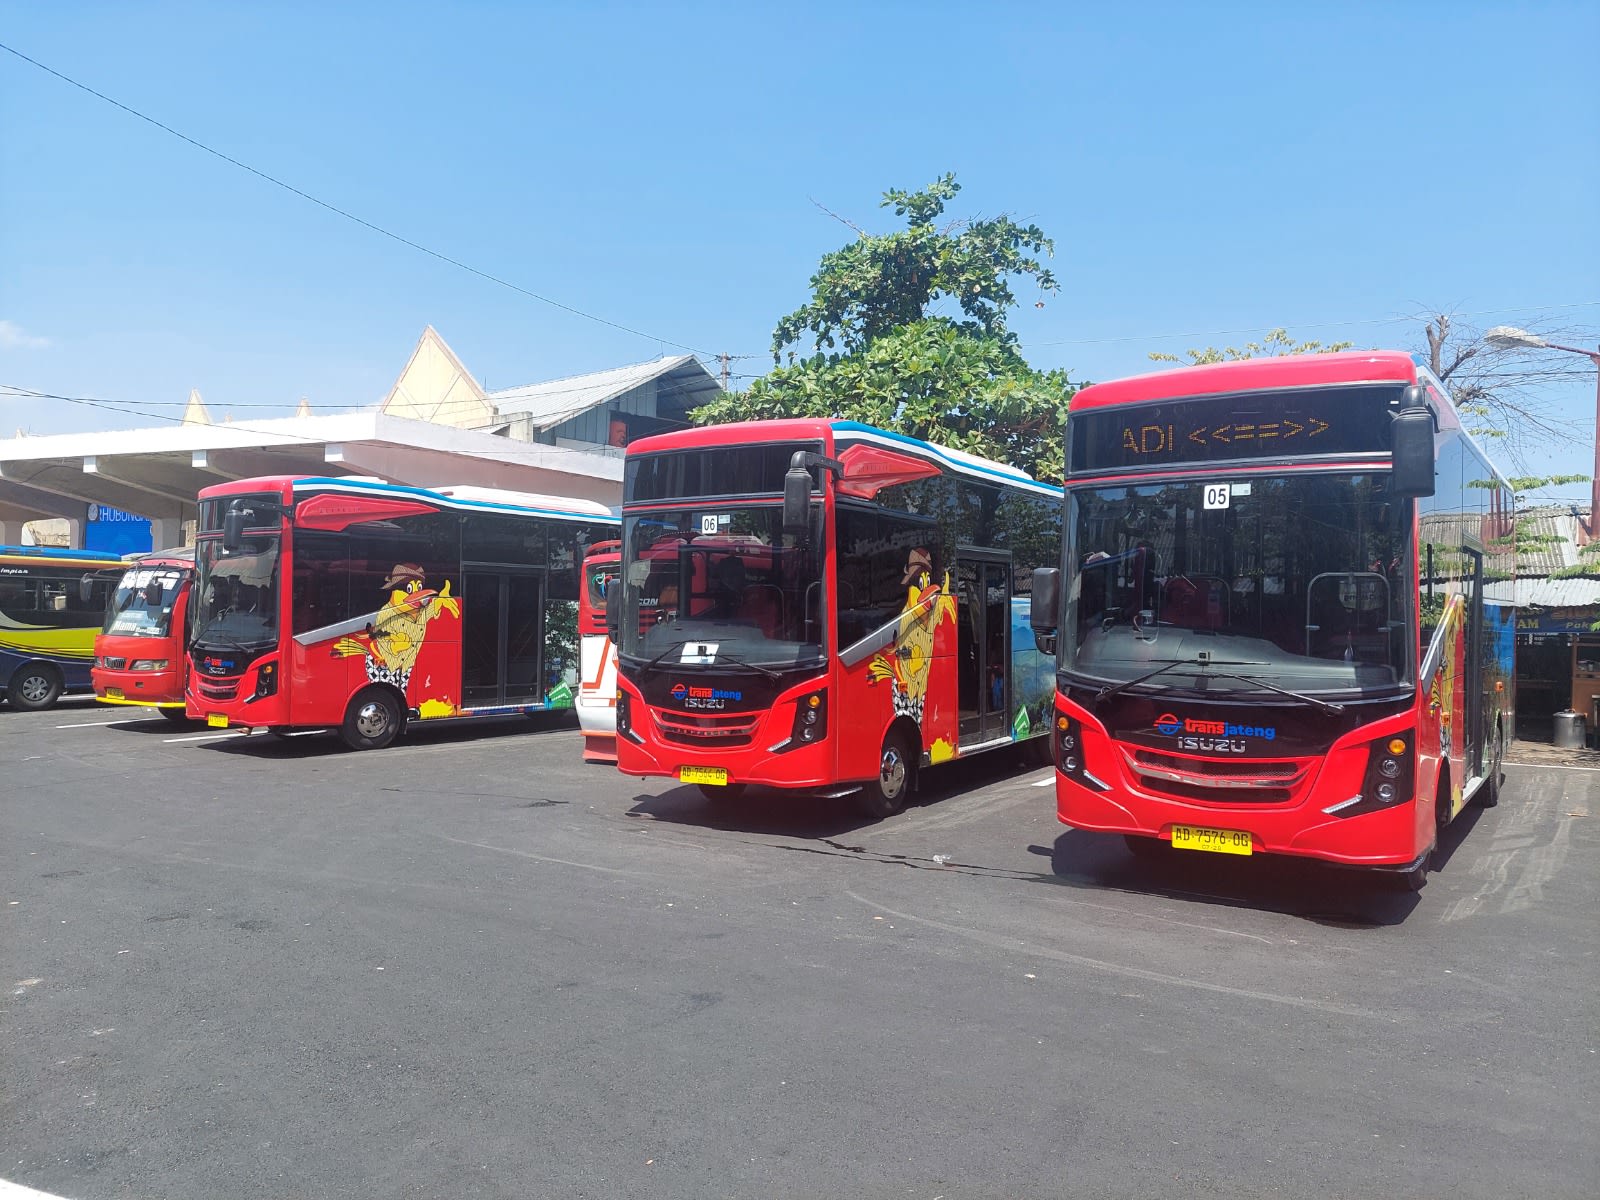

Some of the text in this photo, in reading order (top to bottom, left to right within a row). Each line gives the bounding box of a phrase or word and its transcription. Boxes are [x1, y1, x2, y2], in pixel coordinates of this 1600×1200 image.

[1207, 488, 1227, 505] 05
[704, 518, 716, 531] 06
[689, 686, 742, 701] transjateng
[1185, 718, 1276, 740] transjateng
